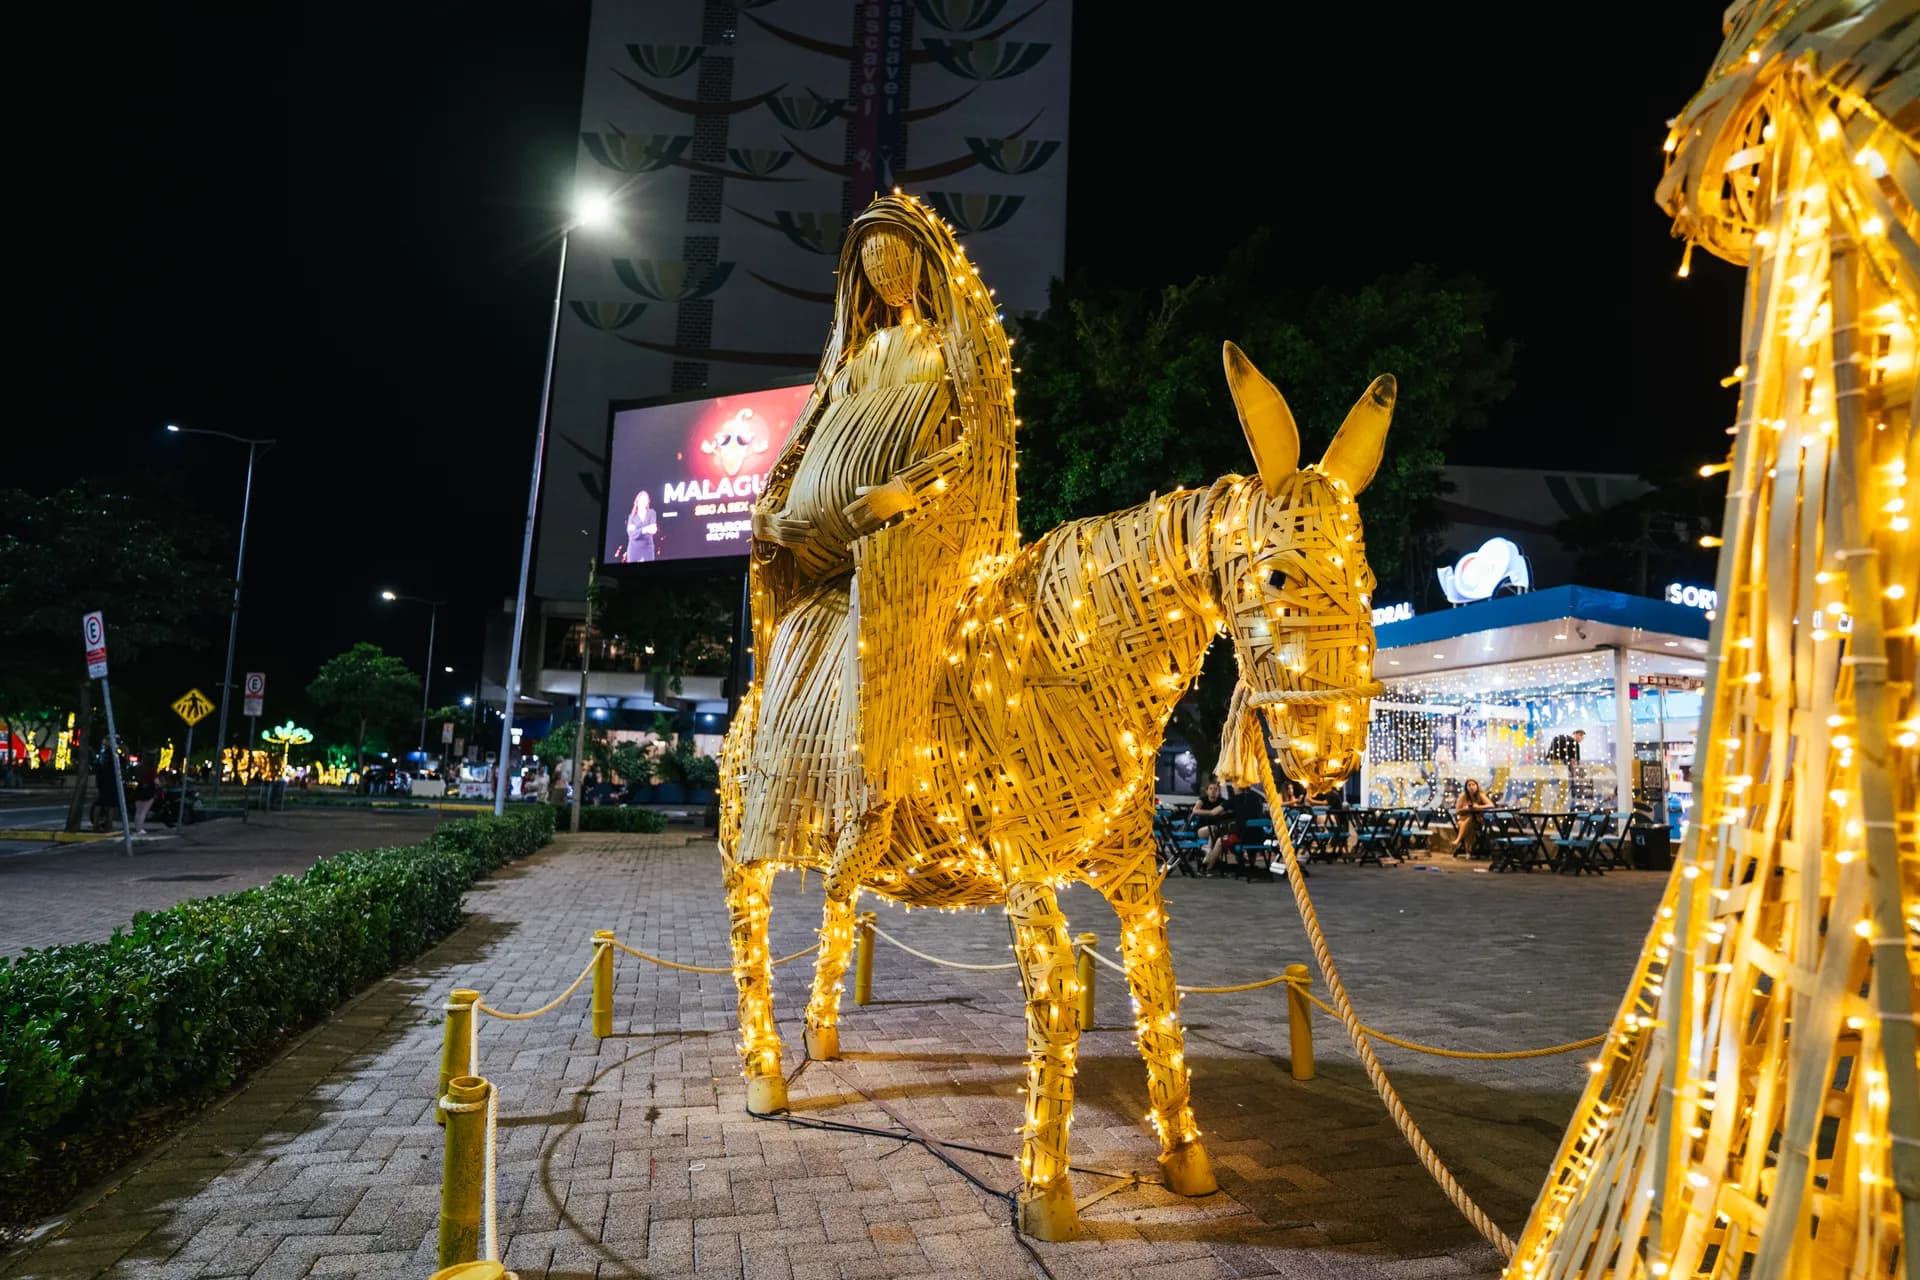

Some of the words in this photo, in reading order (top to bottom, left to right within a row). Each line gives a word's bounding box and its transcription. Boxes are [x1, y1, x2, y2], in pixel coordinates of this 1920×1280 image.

[860, 0, 880, 117] ascavel
[883, 0, 903, 116] ascavel
[90, 622, 97, 639] E
[252, 678, 259, 690] E
